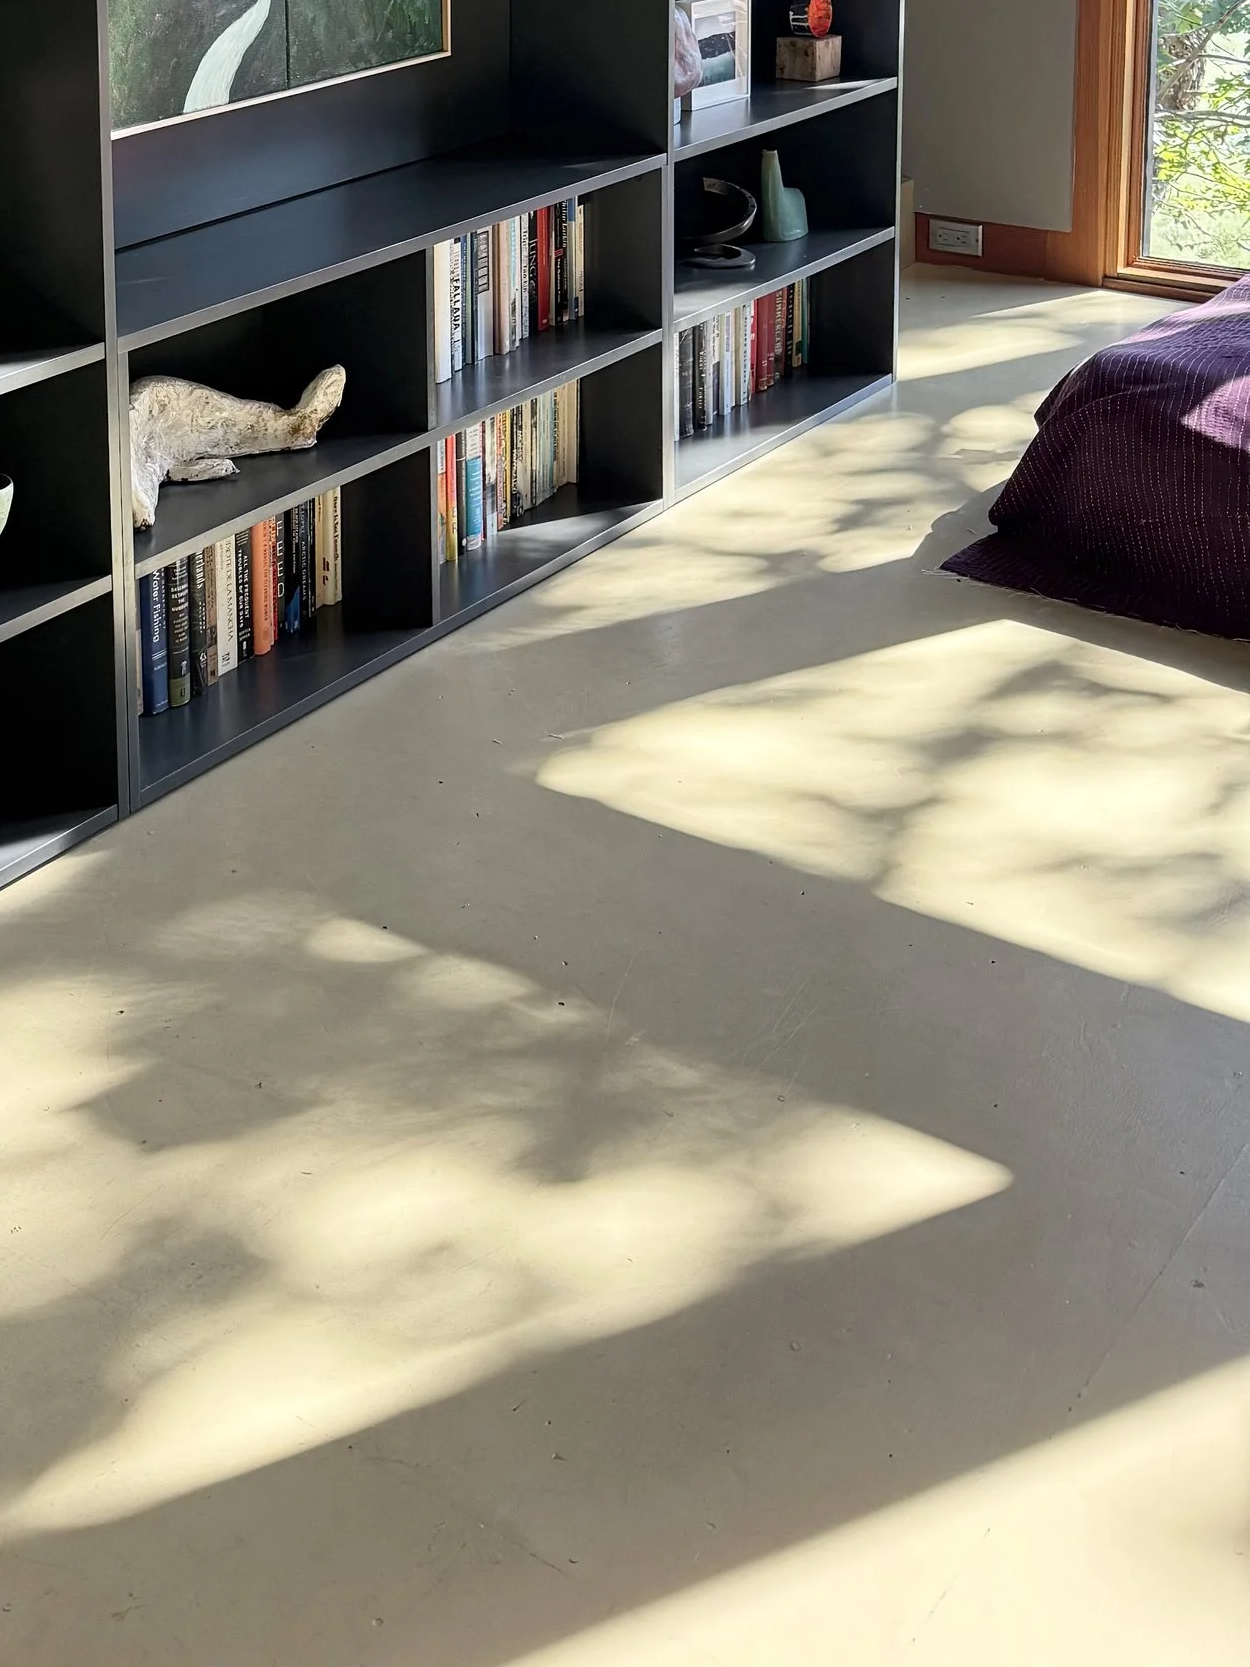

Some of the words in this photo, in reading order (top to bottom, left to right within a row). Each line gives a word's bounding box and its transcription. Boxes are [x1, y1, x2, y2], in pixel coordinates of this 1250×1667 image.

[529, 239, 538, 277] JUNG
[276, 521, 285, 598] FEED
[152, 570, 161, 602] Water
[151, 604, 162, 643] Fishing
